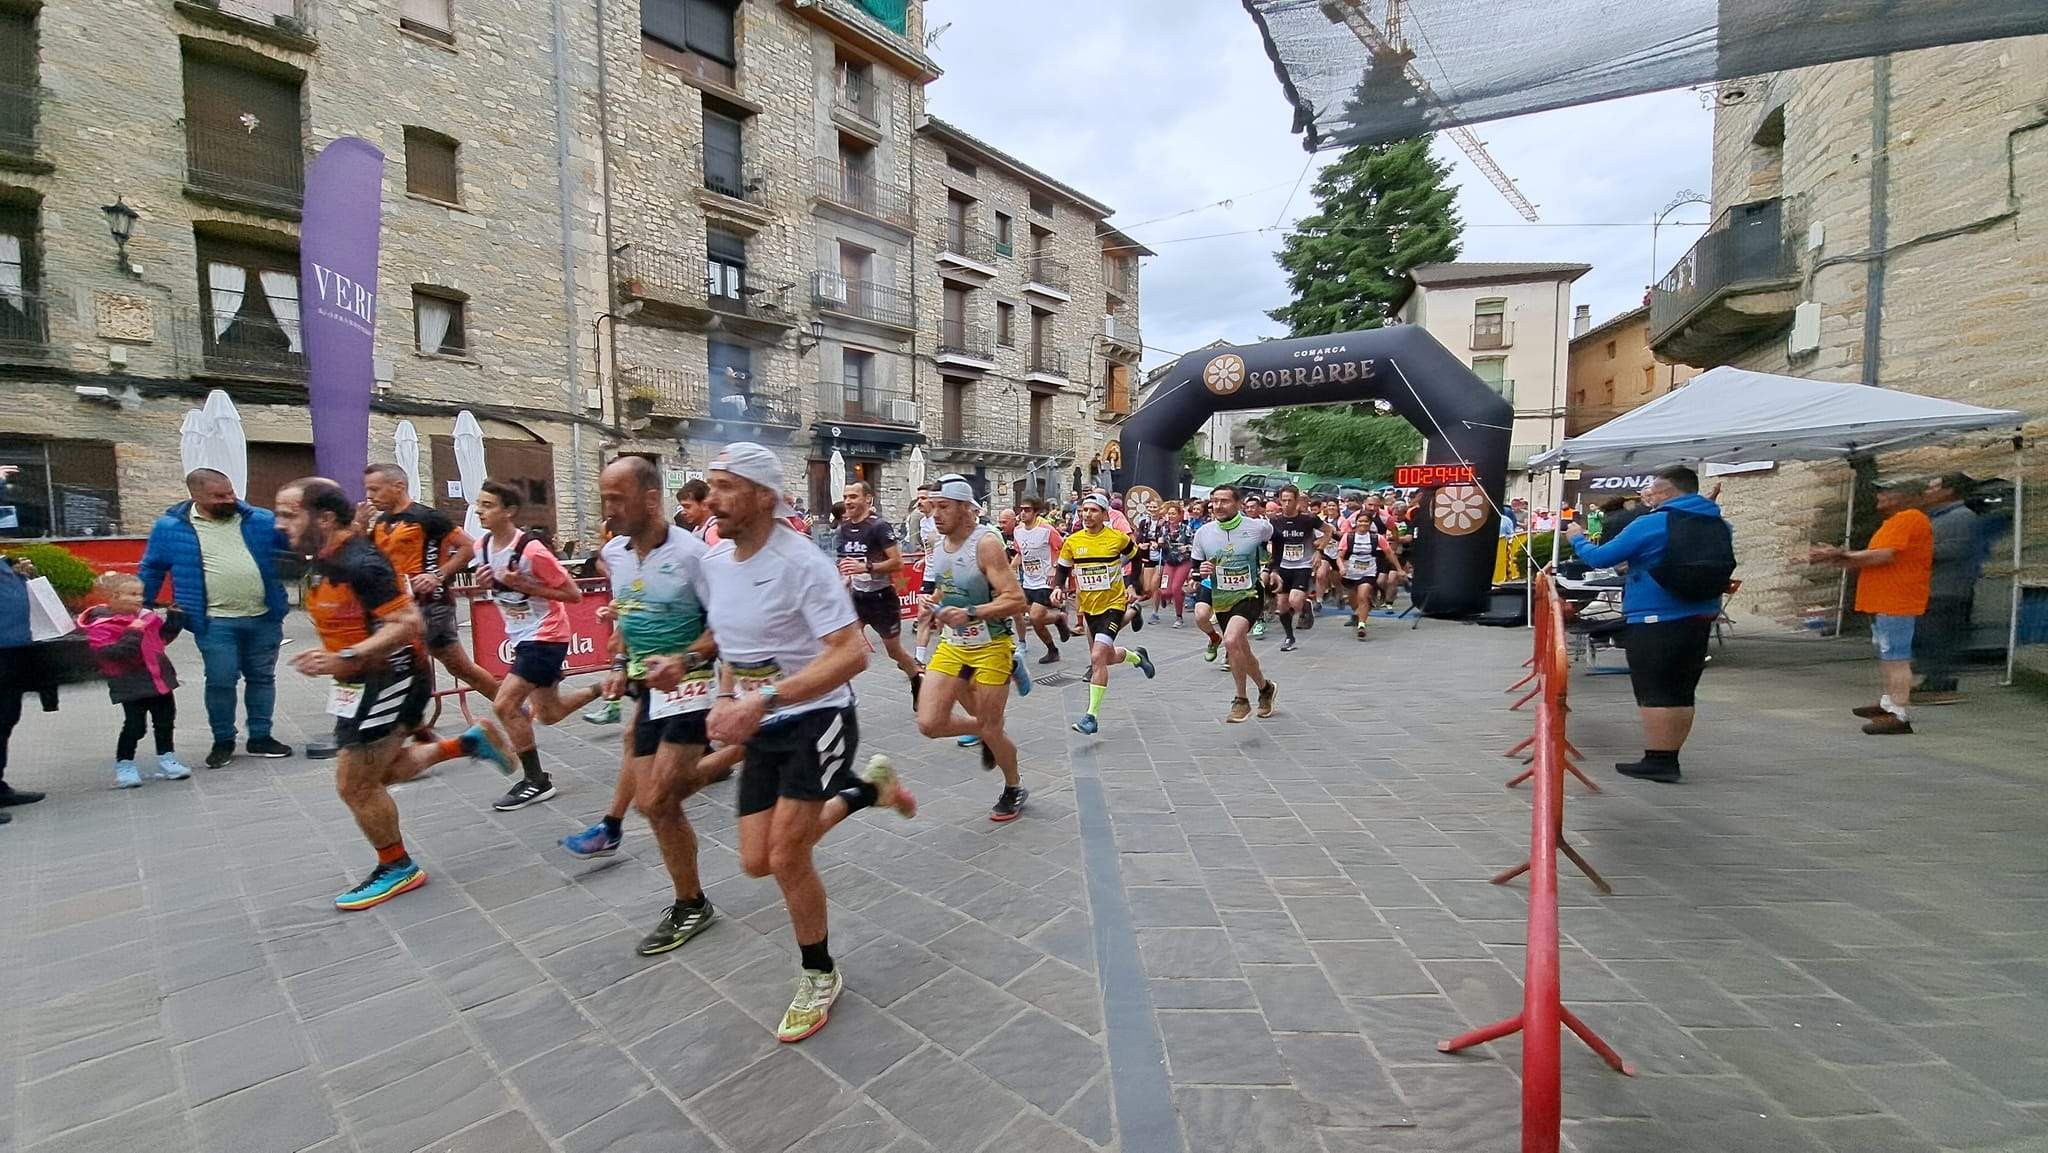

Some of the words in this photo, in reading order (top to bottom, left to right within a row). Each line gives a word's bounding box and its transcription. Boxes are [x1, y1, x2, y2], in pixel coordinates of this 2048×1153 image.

[311, 262, 374, 324] VERI
[1293, 346, 1346, 358] COMARCA
[1249, 359, 1376, 390] SOBRARBE
[1398, 466, 1472, 485] 00:29:44
[1589, 475, 1656, 489] ZONA
[1083, 576, 1102, 584] 1114
[1224, 576, 1245, 584] 1124
